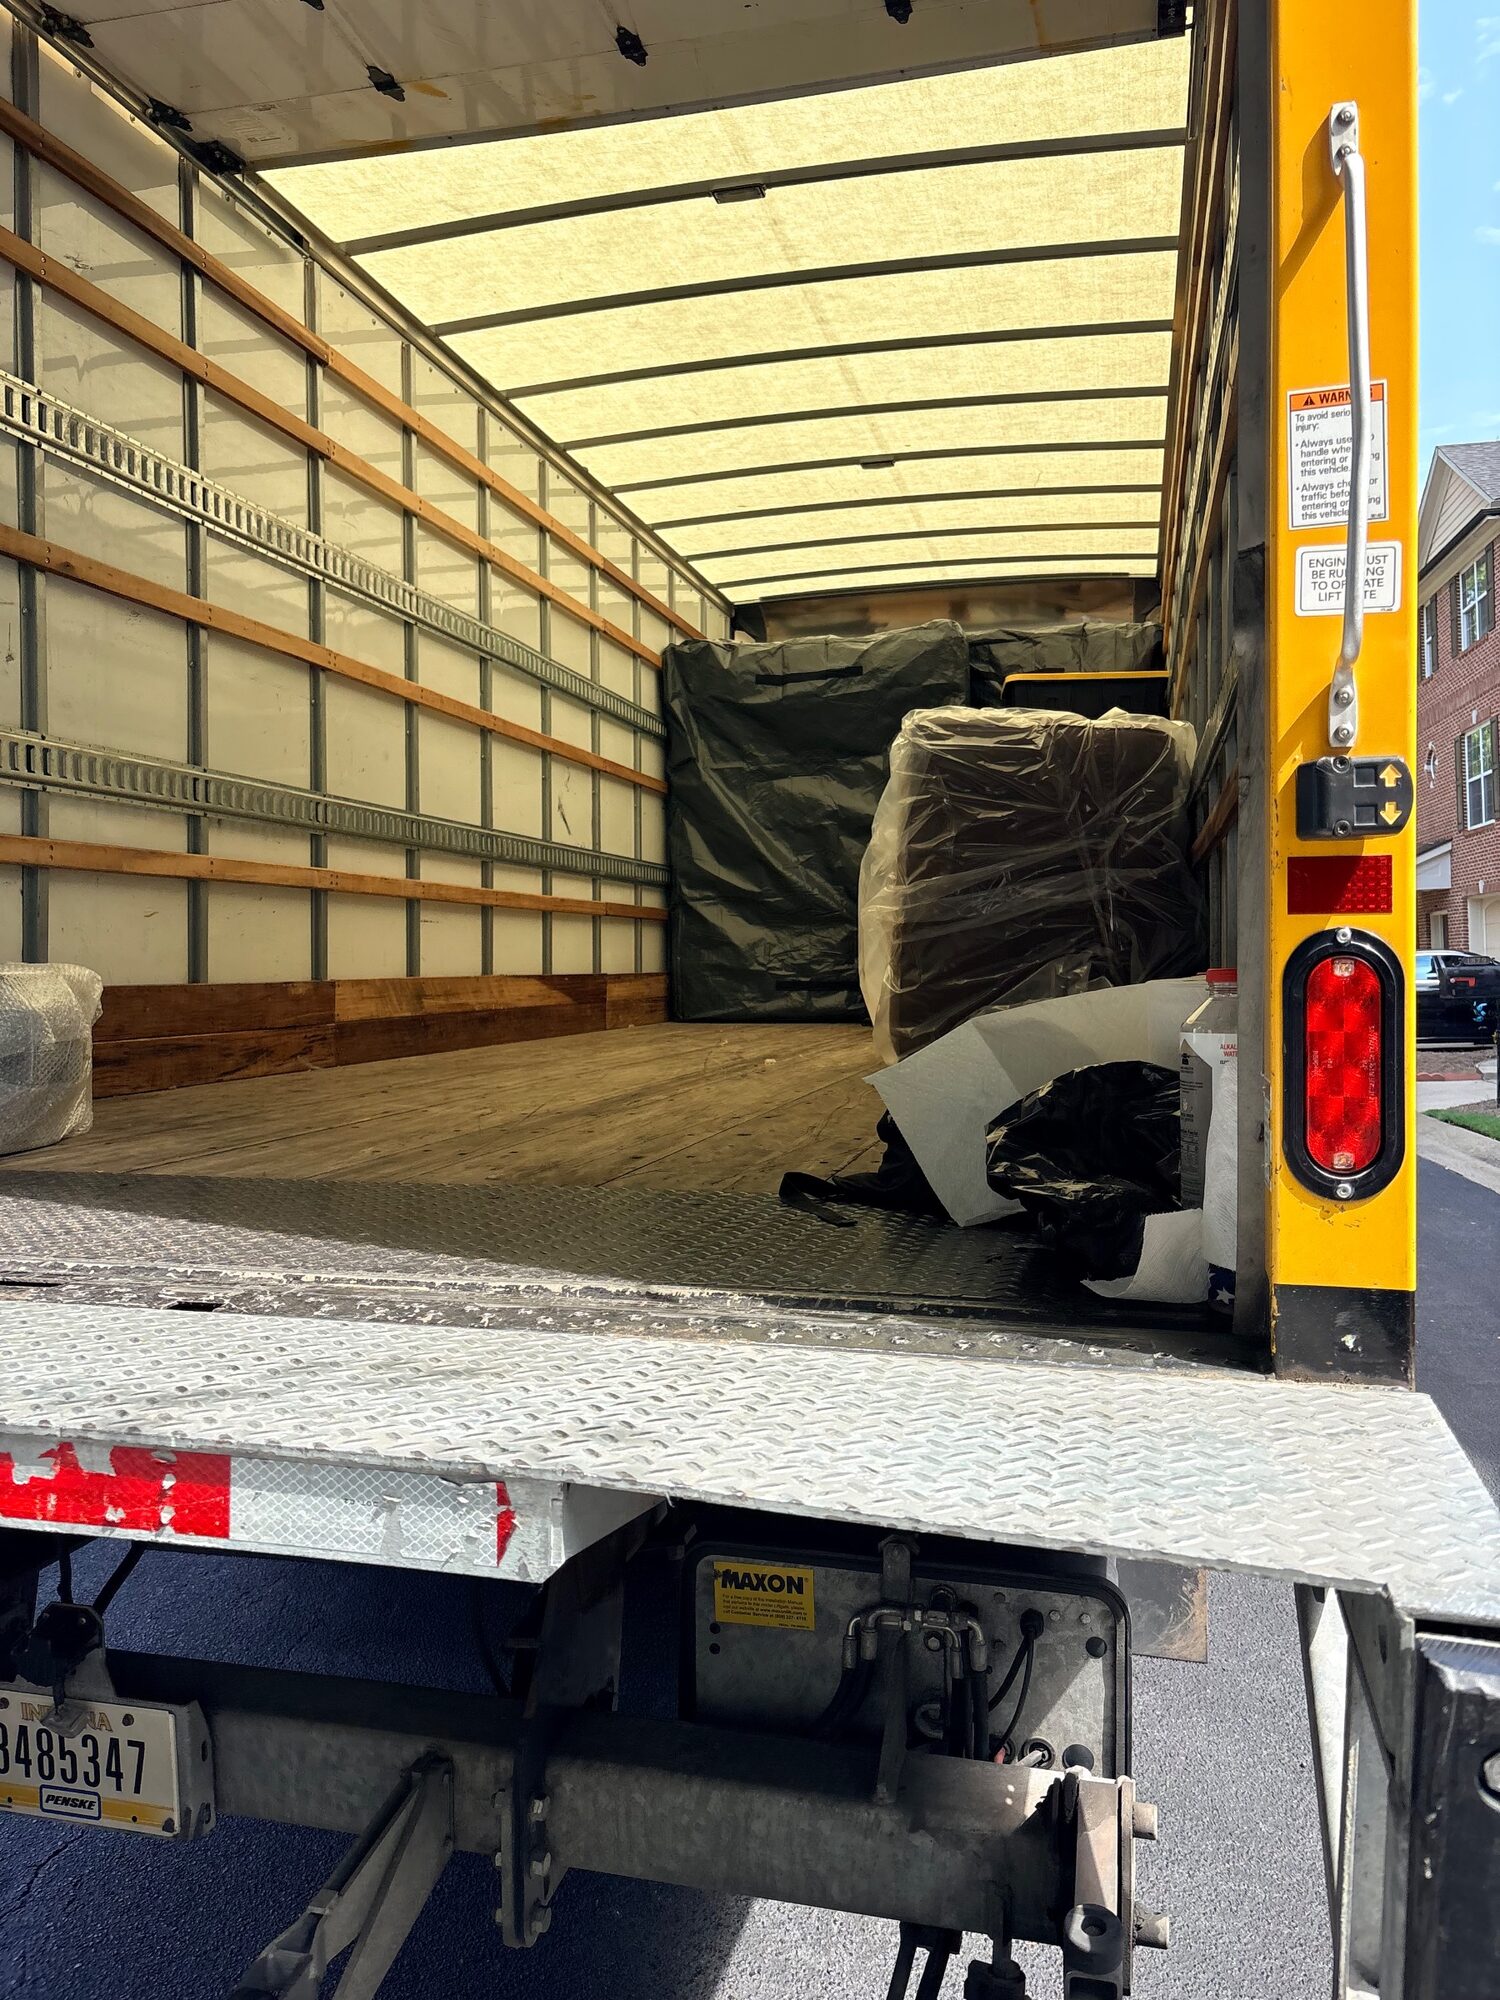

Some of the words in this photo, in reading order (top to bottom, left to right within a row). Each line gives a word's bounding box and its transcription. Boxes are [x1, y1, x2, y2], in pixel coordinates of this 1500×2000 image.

[1319, 388, 1373, 404] WARN
[1295, 414, 1304, 422] To
[1307, 410, 1328, 421] avoid
[1331, 408, 1352, 418] serio
[1295, 422, 1320, 433] injury:
[1300, 438, 1333, 450] Always
[1300, 447, 1328, 458] handle
[1331, 445, 1351, 454] whe
[1301, 457, 1336, 468] entering
[1339, 455, 1348, 463] or
[1301, 467, 1316, 477] this
[1301, 482, 1334, 493] Always
[1301, 491, 1328, 502] traffic
[1330, 489, 1350, 498] befo
[1301, 499, 1337, 511] entering
[1340, 500, 1349, 508] or
[1302, 511, 1318, 520] this
[1308, 557, 1345, 568] ENGIN
[1366, 554, 1388, 565] UST
[1311, 570, 1326, 580] BE
[1328, 566, 1385, 578] RUNG
[1311, 580, 1328, 590] TO
[1331, 578, 1384, 590] OPATE
[1318, 592, 1342, 602] LIFT
[1364, 590, 1376, 600] TE
[722, 1569, 804, 1595] MAXON
[21, 1702, 113, 1732] INNA
[45, 1794, 96, 1810] PENSKE
